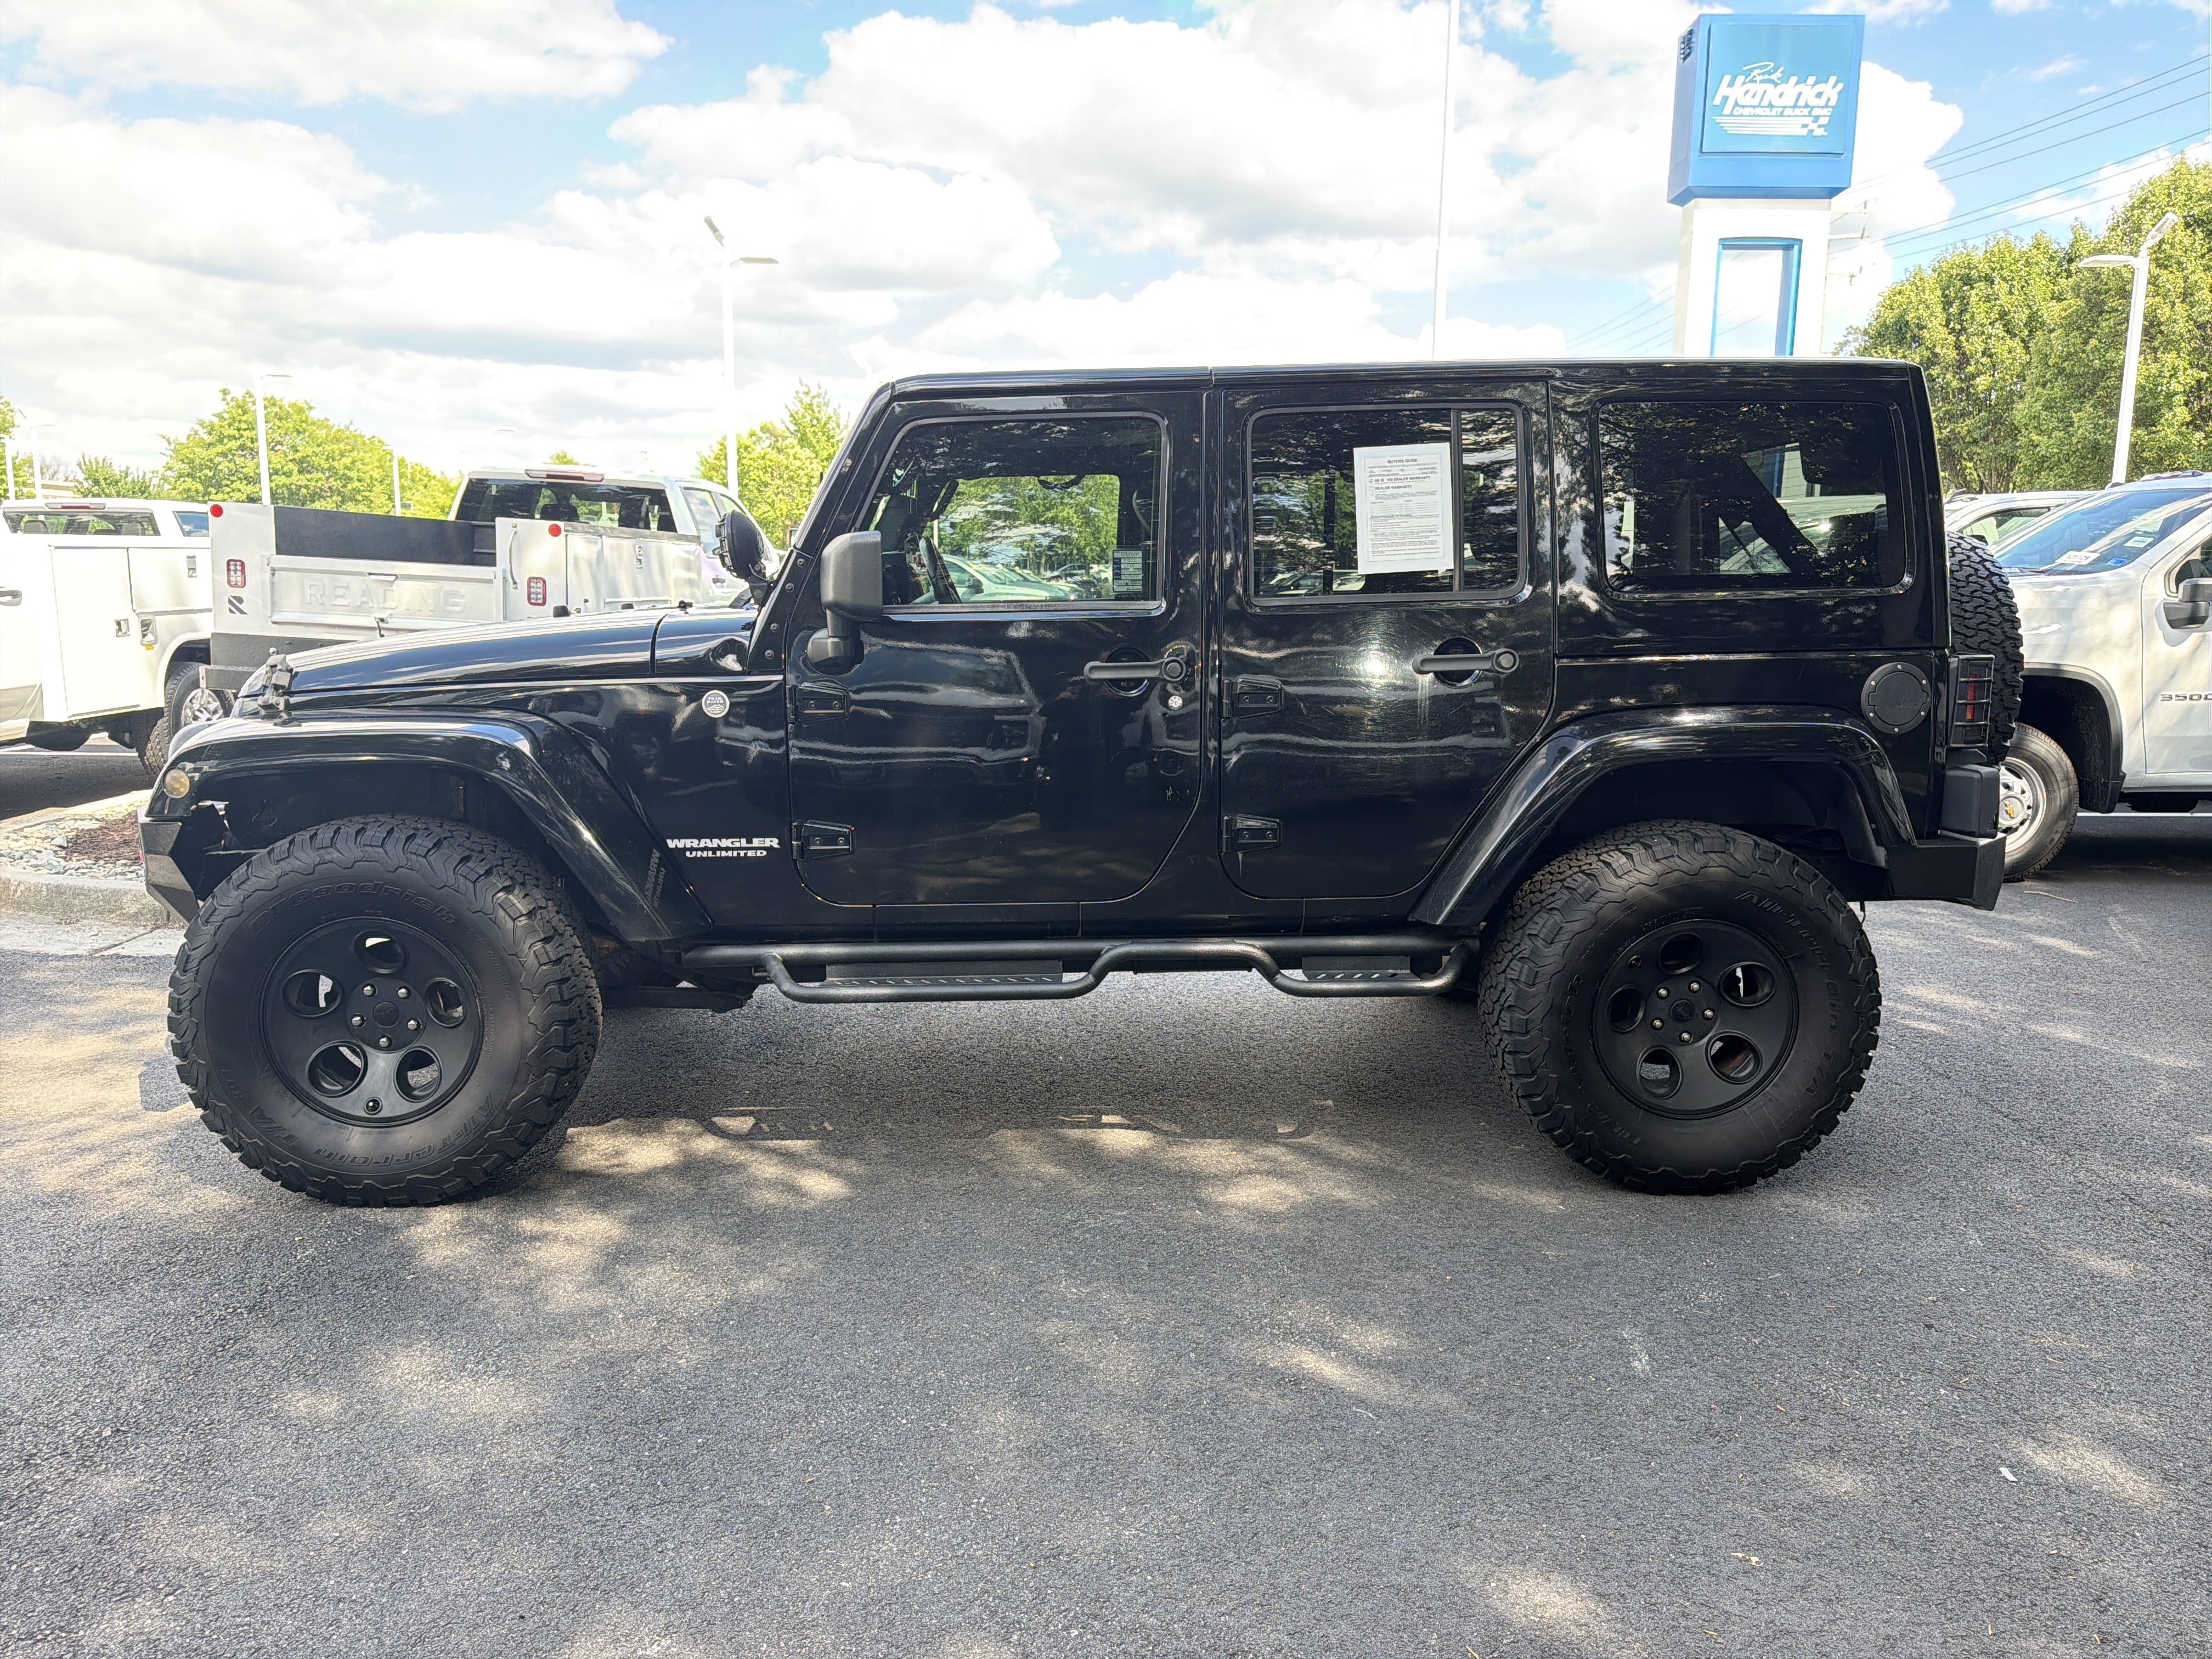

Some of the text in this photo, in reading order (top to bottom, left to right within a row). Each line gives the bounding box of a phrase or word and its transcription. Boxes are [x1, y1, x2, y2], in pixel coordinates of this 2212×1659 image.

[1712, 75, 1844, 115] Hendrick
[2160, 693, 2212, 702] 3500
[666, 838, 780, 848] WRANGLER
[314, 1091, 494, 1167] All-Terrain
